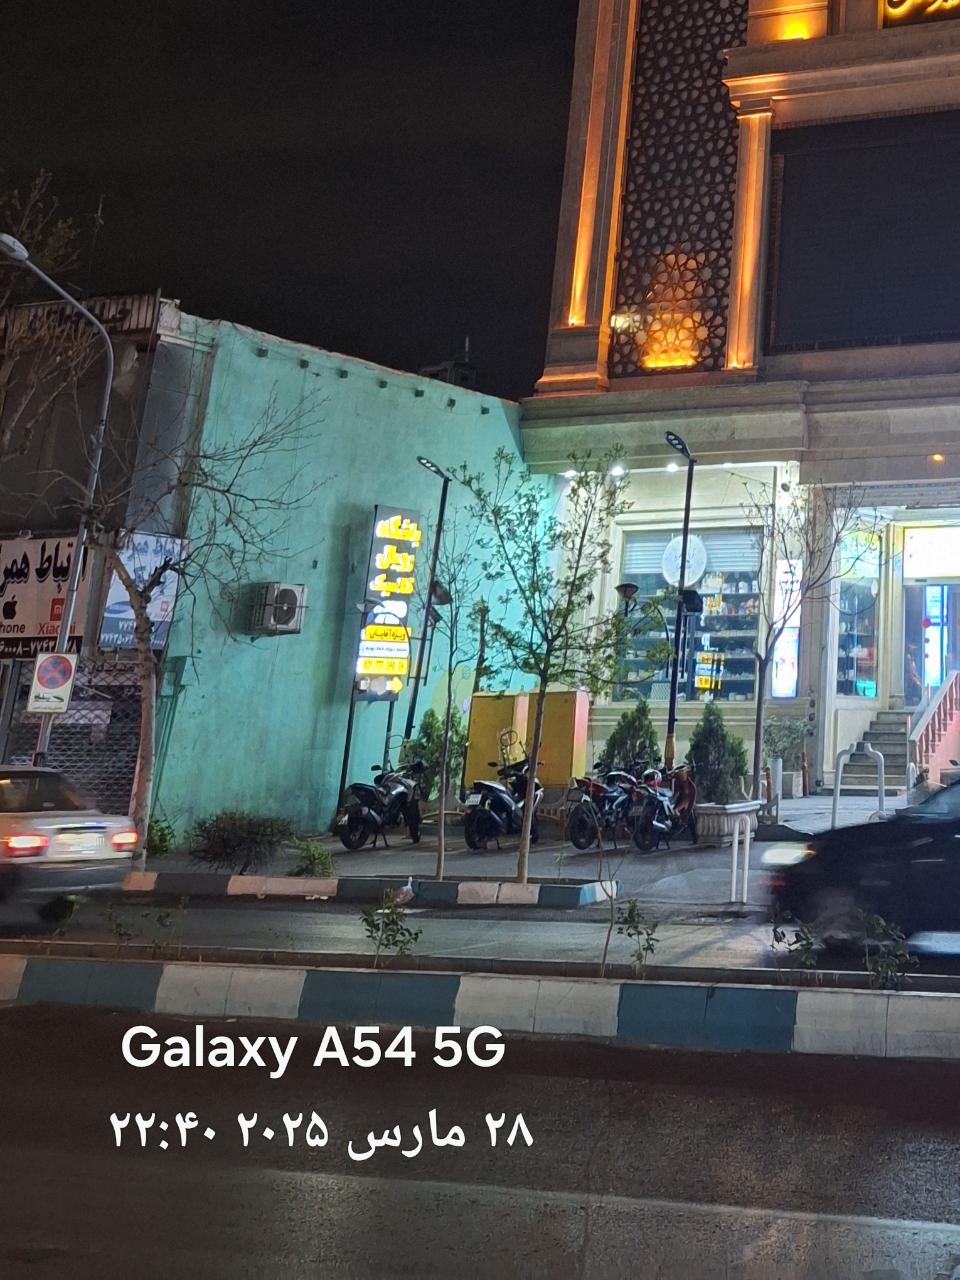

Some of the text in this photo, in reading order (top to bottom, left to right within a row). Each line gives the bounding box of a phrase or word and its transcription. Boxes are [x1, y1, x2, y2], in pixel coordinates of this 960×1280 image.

[0, 541, 88, 597] اتباط همر
[37, 622, 76, 635] Xiaoi
